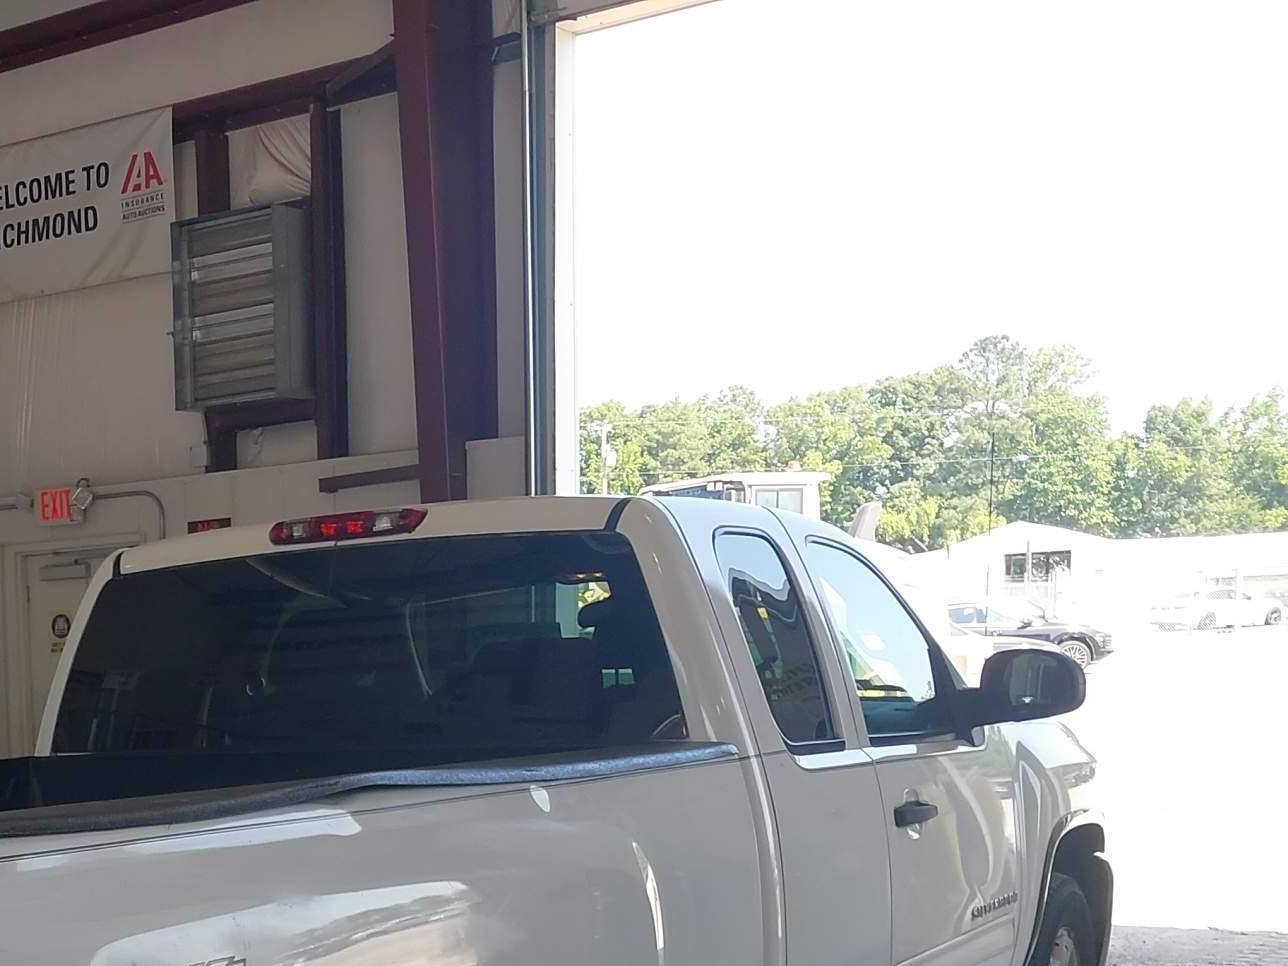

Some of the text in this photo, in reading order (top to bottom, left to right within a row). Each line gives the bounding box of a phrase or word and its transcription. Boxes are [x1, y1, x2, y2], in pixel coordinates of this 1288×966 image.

[82, 161, 110, 192] TO
[120, 192, 164, 209] INSURANCE
[40, 488, 72, 522] EXIT
